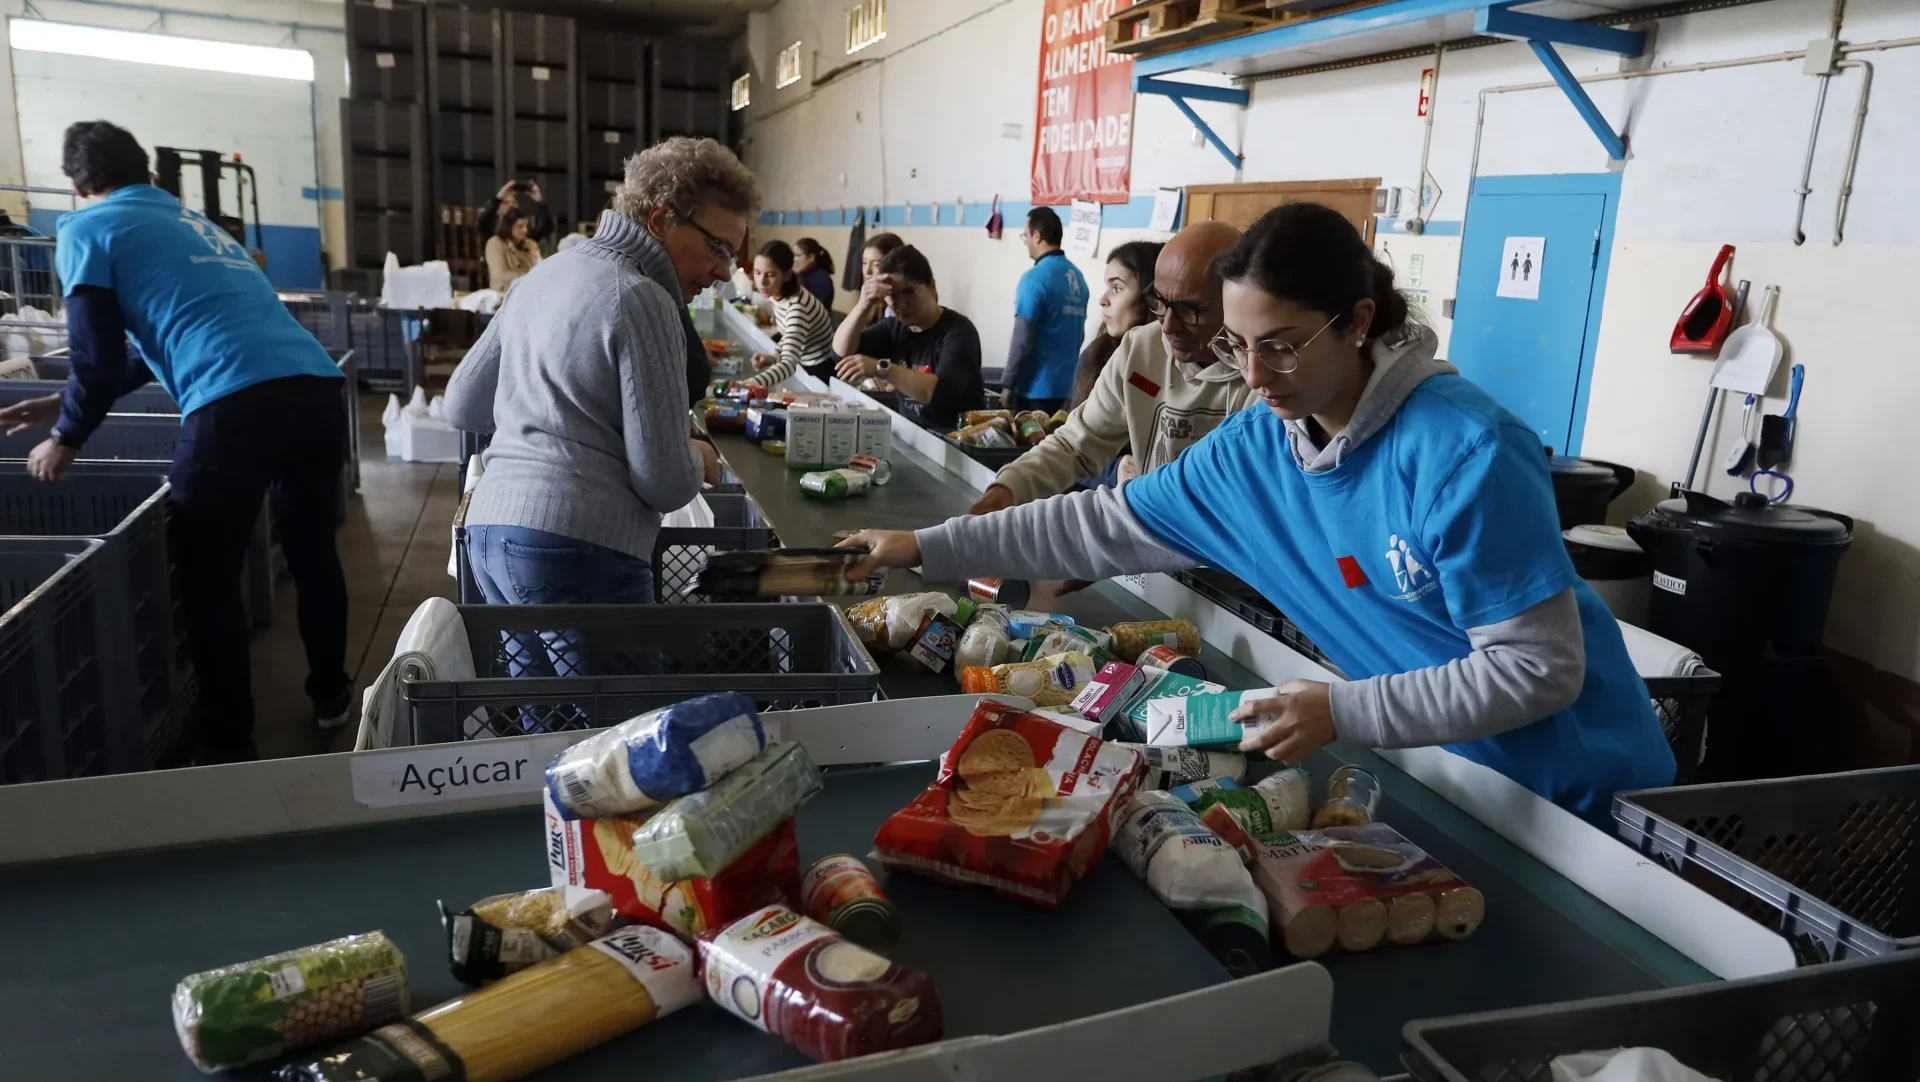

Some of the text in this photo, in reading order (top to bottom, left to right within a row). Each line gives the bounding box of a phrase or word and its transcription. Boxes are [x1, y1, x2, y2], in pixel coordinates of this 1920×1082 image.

[1045, 14, 1058, 44] O
[1042, 85, 1070, 119] TEM
[1040, 113, 1130, 154] FIDELIDADE
[400, 756, 527, 796] Açúcar
